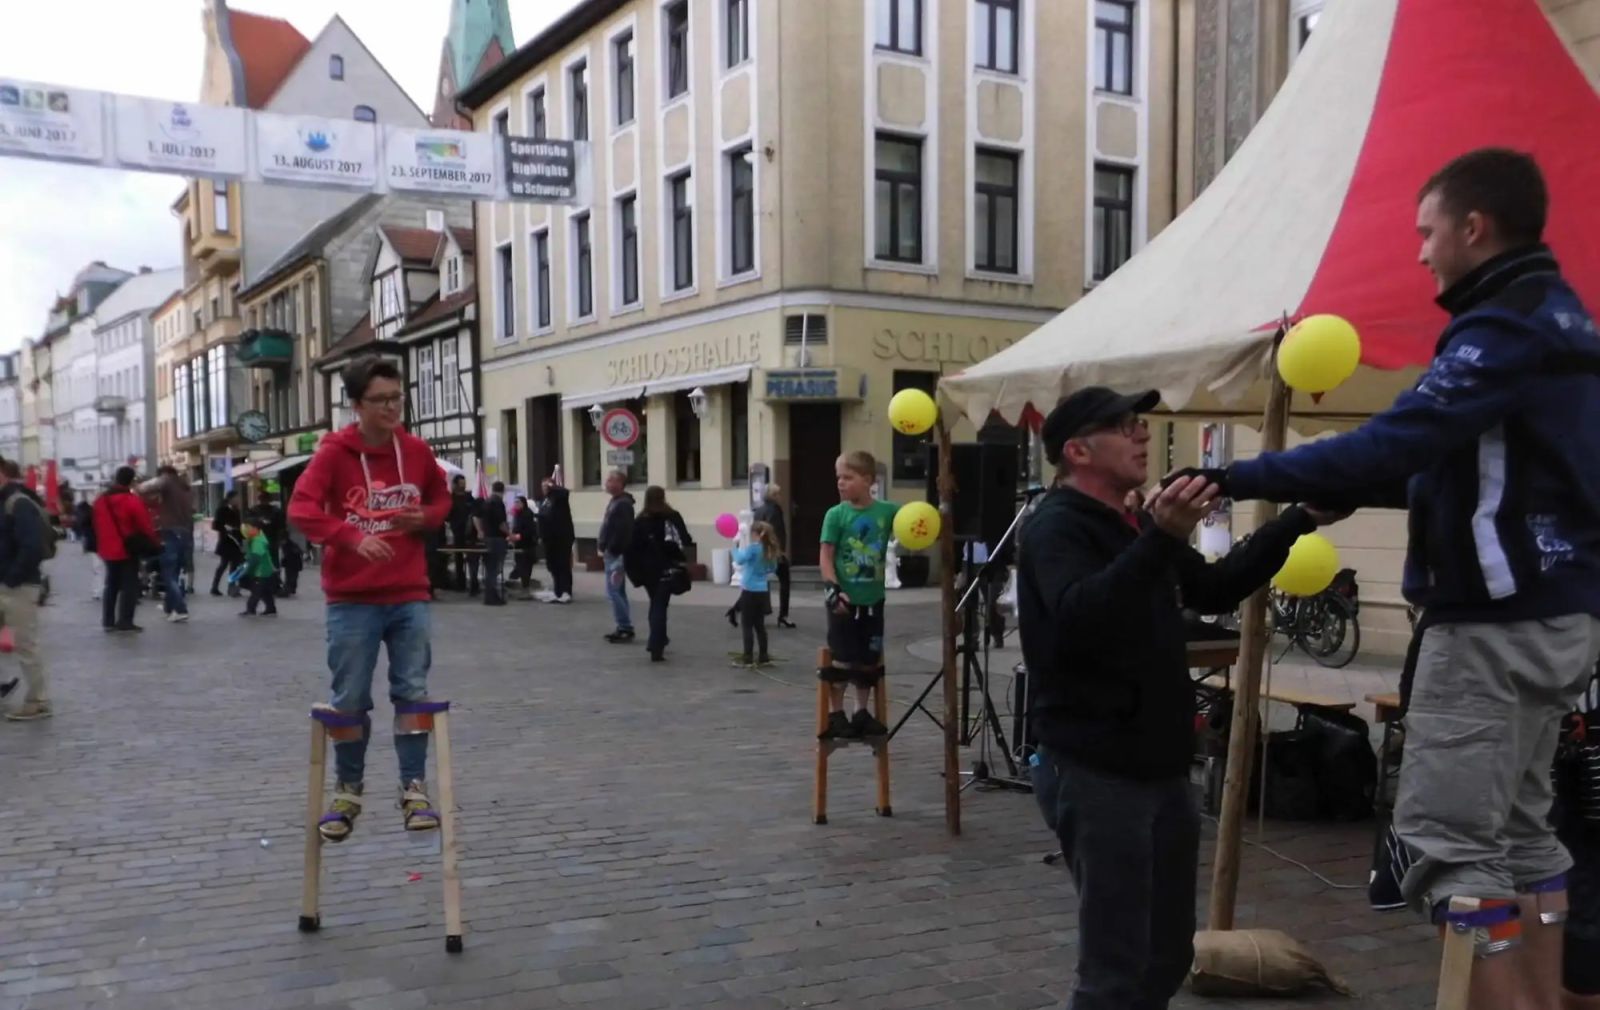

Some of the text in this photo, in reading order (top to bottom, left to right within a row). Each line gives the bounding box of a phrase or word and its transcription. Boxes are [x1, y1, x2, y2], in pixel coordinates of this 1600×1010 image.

[189, 145, 216, 159] 2017
[292, 155, 336, 171] AUGUST
[337, 160, 362, 174] 2017
[391, 164, 492, 184] 23. SEPTEMBER 2017
[606, 330, 761, 387] SCHLOSSHALLE
